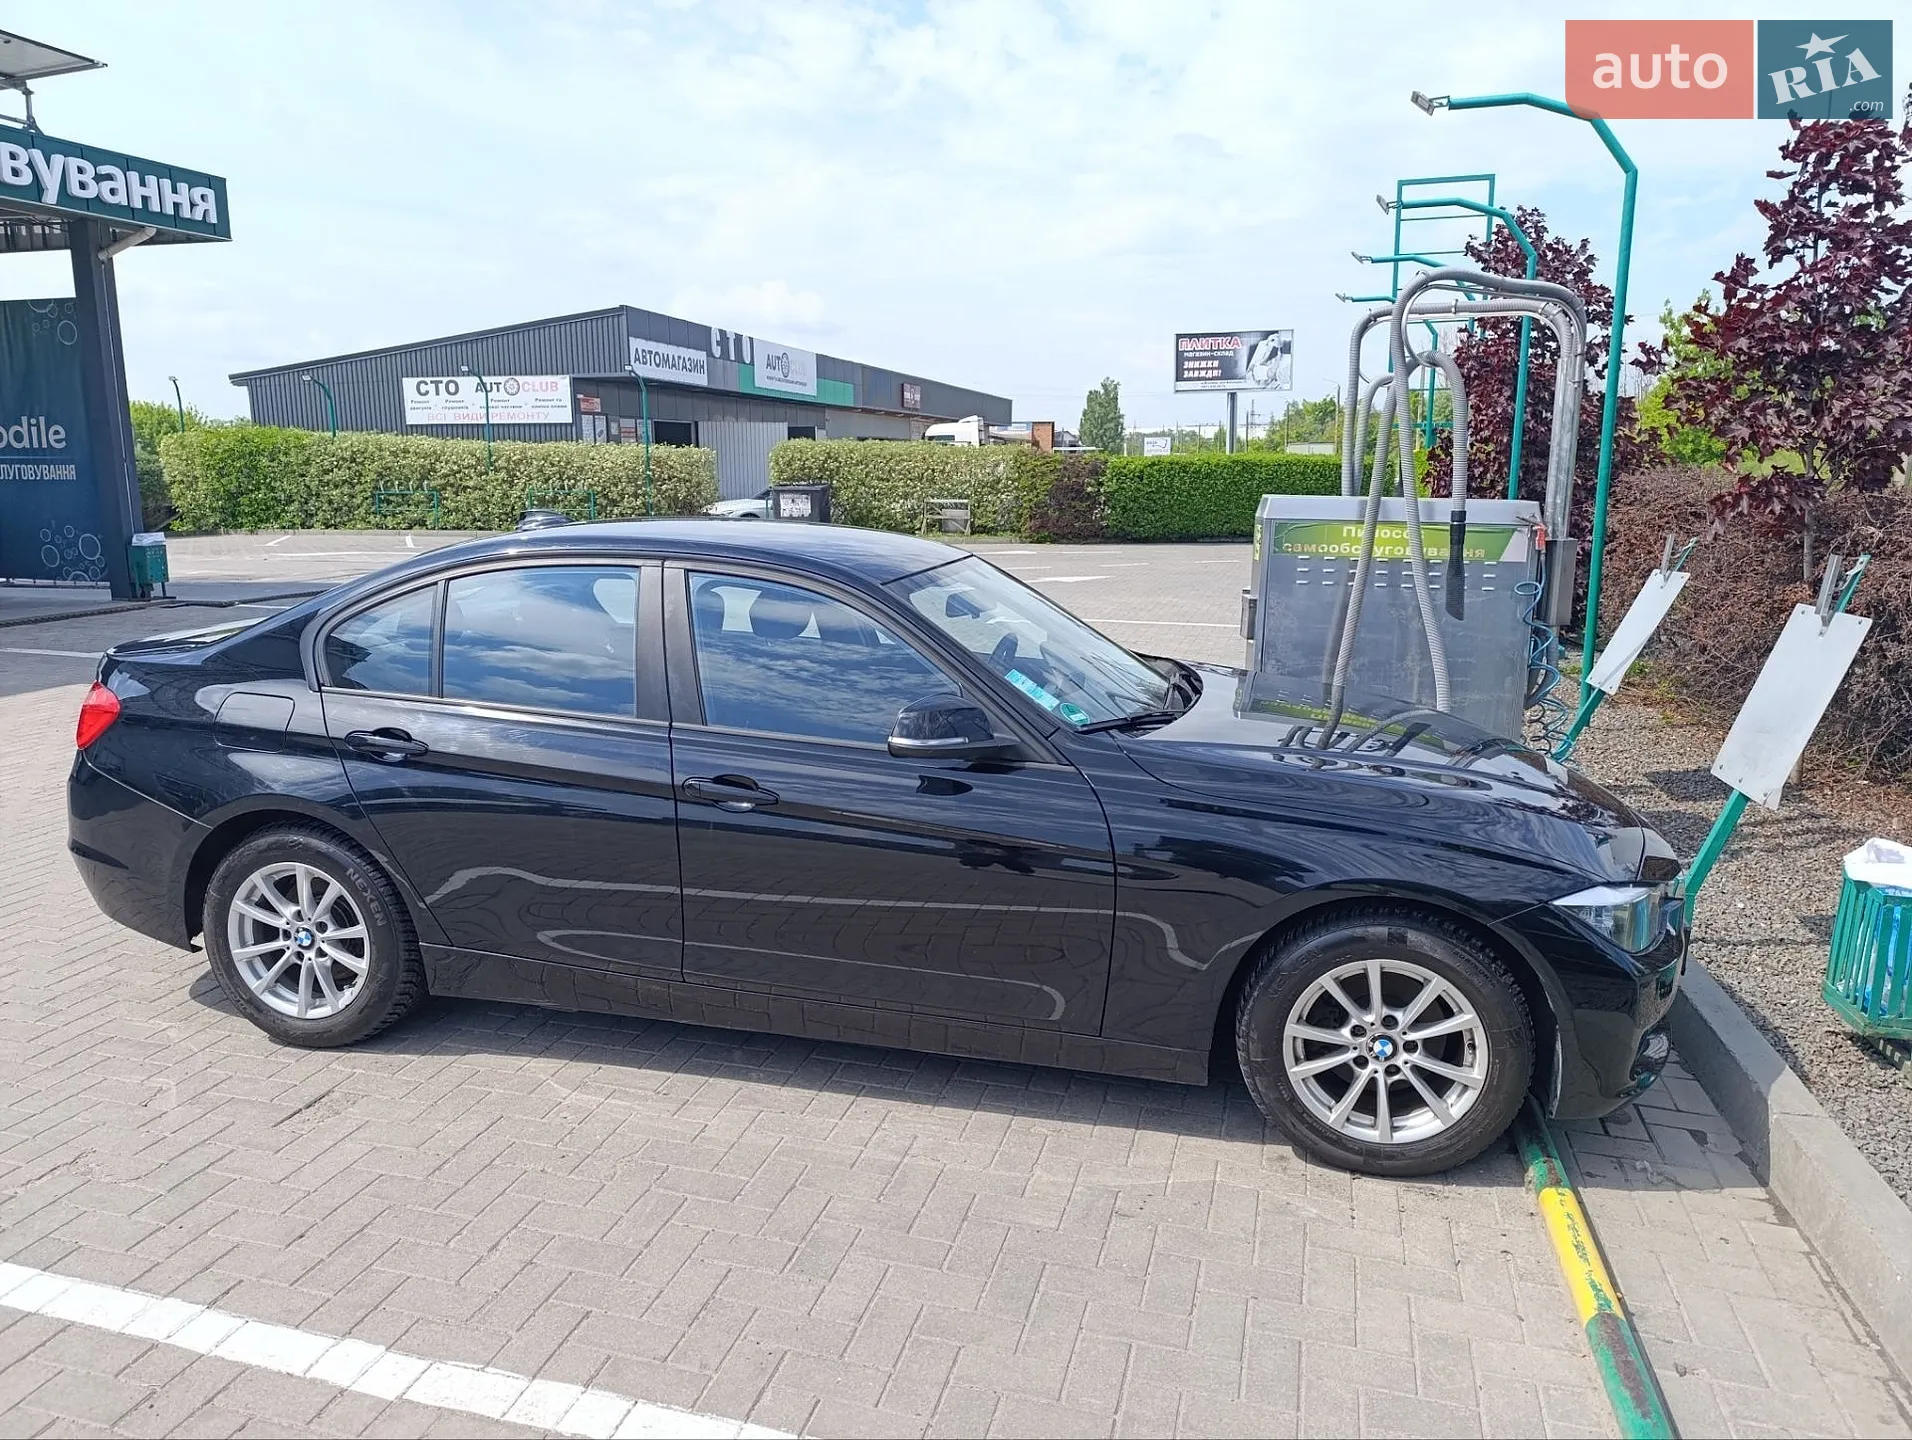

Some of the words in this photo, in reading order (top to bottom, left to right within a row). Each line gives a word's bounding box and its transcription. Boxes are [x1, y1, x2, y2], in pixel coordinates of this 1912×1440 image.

[0, 142, 218, 224] вування
[1178, 336, 1242, 351] ПЛИТКА
[633, 347, 706, 375] АВТОМАГАЗИН
[415, 379, 460, 397] СТО
[491, 411, 549, 421] РЕМОНТУ
[0, 464, 77, 480] ЛУГОВУВАННЯ
[346, 867, 388, 927] NEXEN
